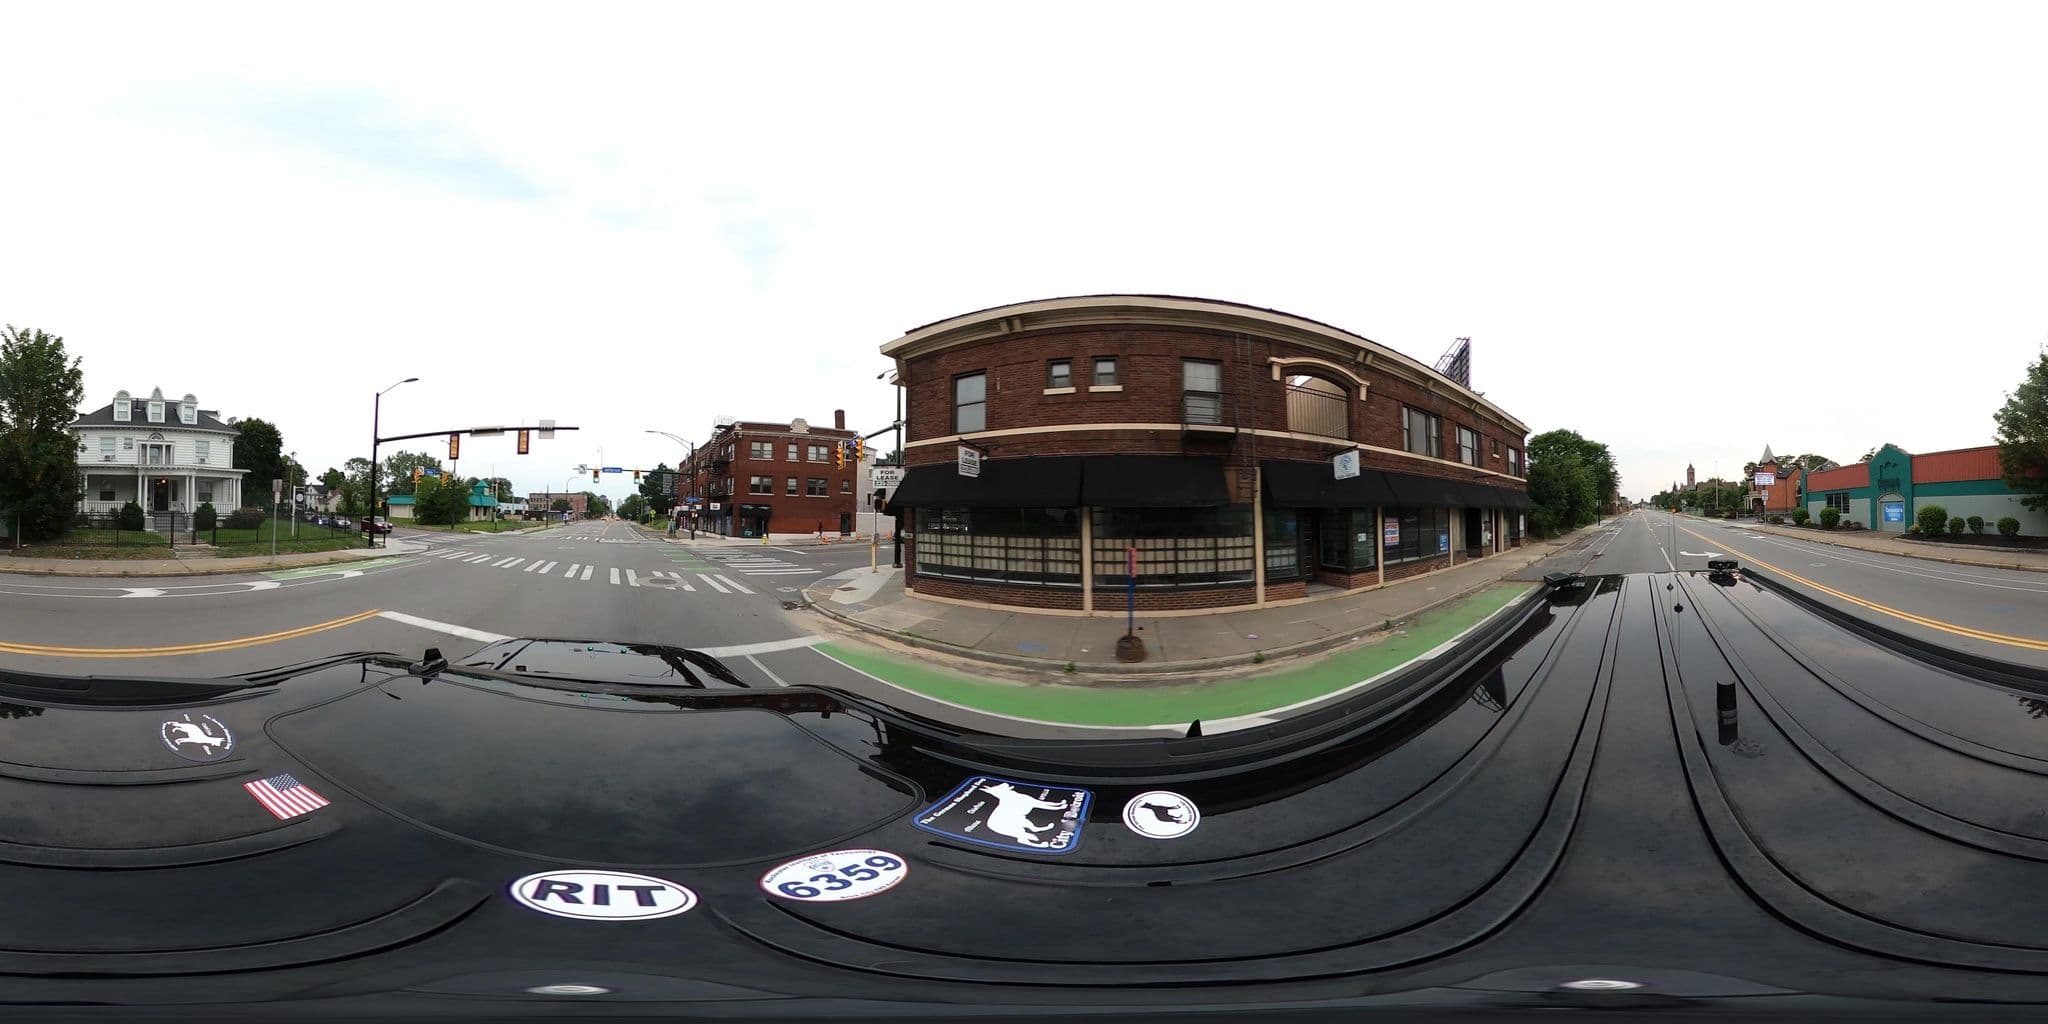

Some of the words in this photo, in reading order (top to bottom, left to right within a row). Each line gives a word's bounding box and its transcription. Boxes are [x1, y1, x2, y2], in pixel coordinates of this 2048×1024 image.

[1049, 830, 1075, 849] City
[1063, 792, 1086, 819] Detroit
[531, 879, 667, 907] RIT
[778, 856, 902, 898] 6359
